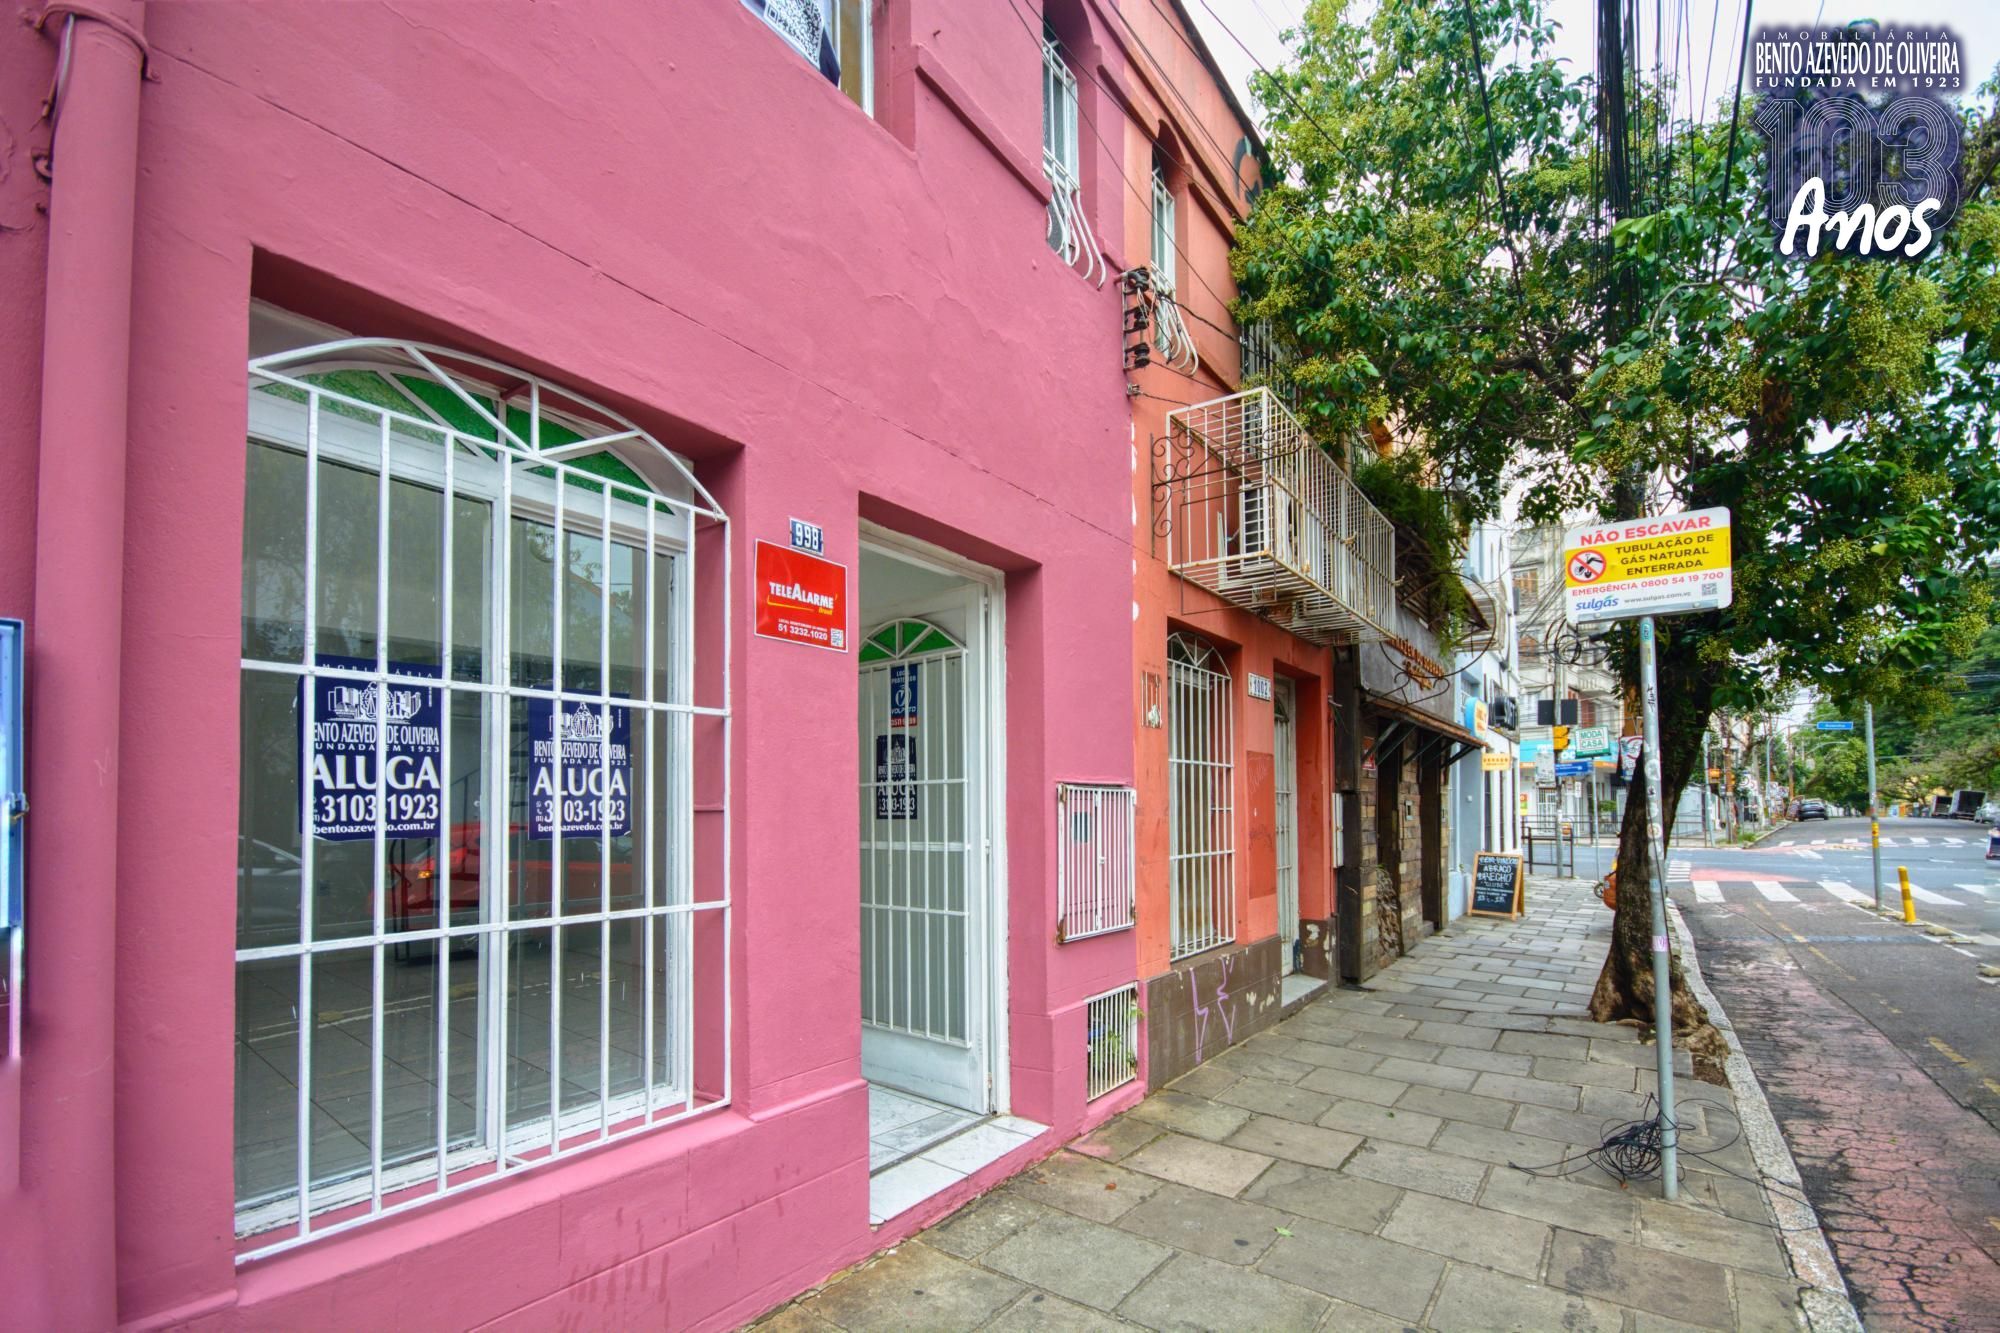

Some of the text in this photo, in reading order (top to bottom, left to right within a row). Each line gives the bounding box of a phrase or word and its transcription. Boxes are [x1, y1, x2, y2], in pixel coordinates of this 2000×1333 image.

[795, 523, 819, 550] 998
[1580, 516, 1711, 546] NÃO ESCAVAR
[1615, 534, 1714, 554] TUBULAÇÃO DE
[1620, 552, 1646, 565] GÁS
[1649, 547, 1710, 562] NATURAL
[1626, 559, 1703, 576] ENTERRADA
[1572, 571, 1724, 597] EMERGÊNCIA 0800 54 19 700
[401, 726, 439, 746] OLIVEIRA
[1580, 730, 1603, 738] MODA
[1581, 740, 1603, 748] CASA
